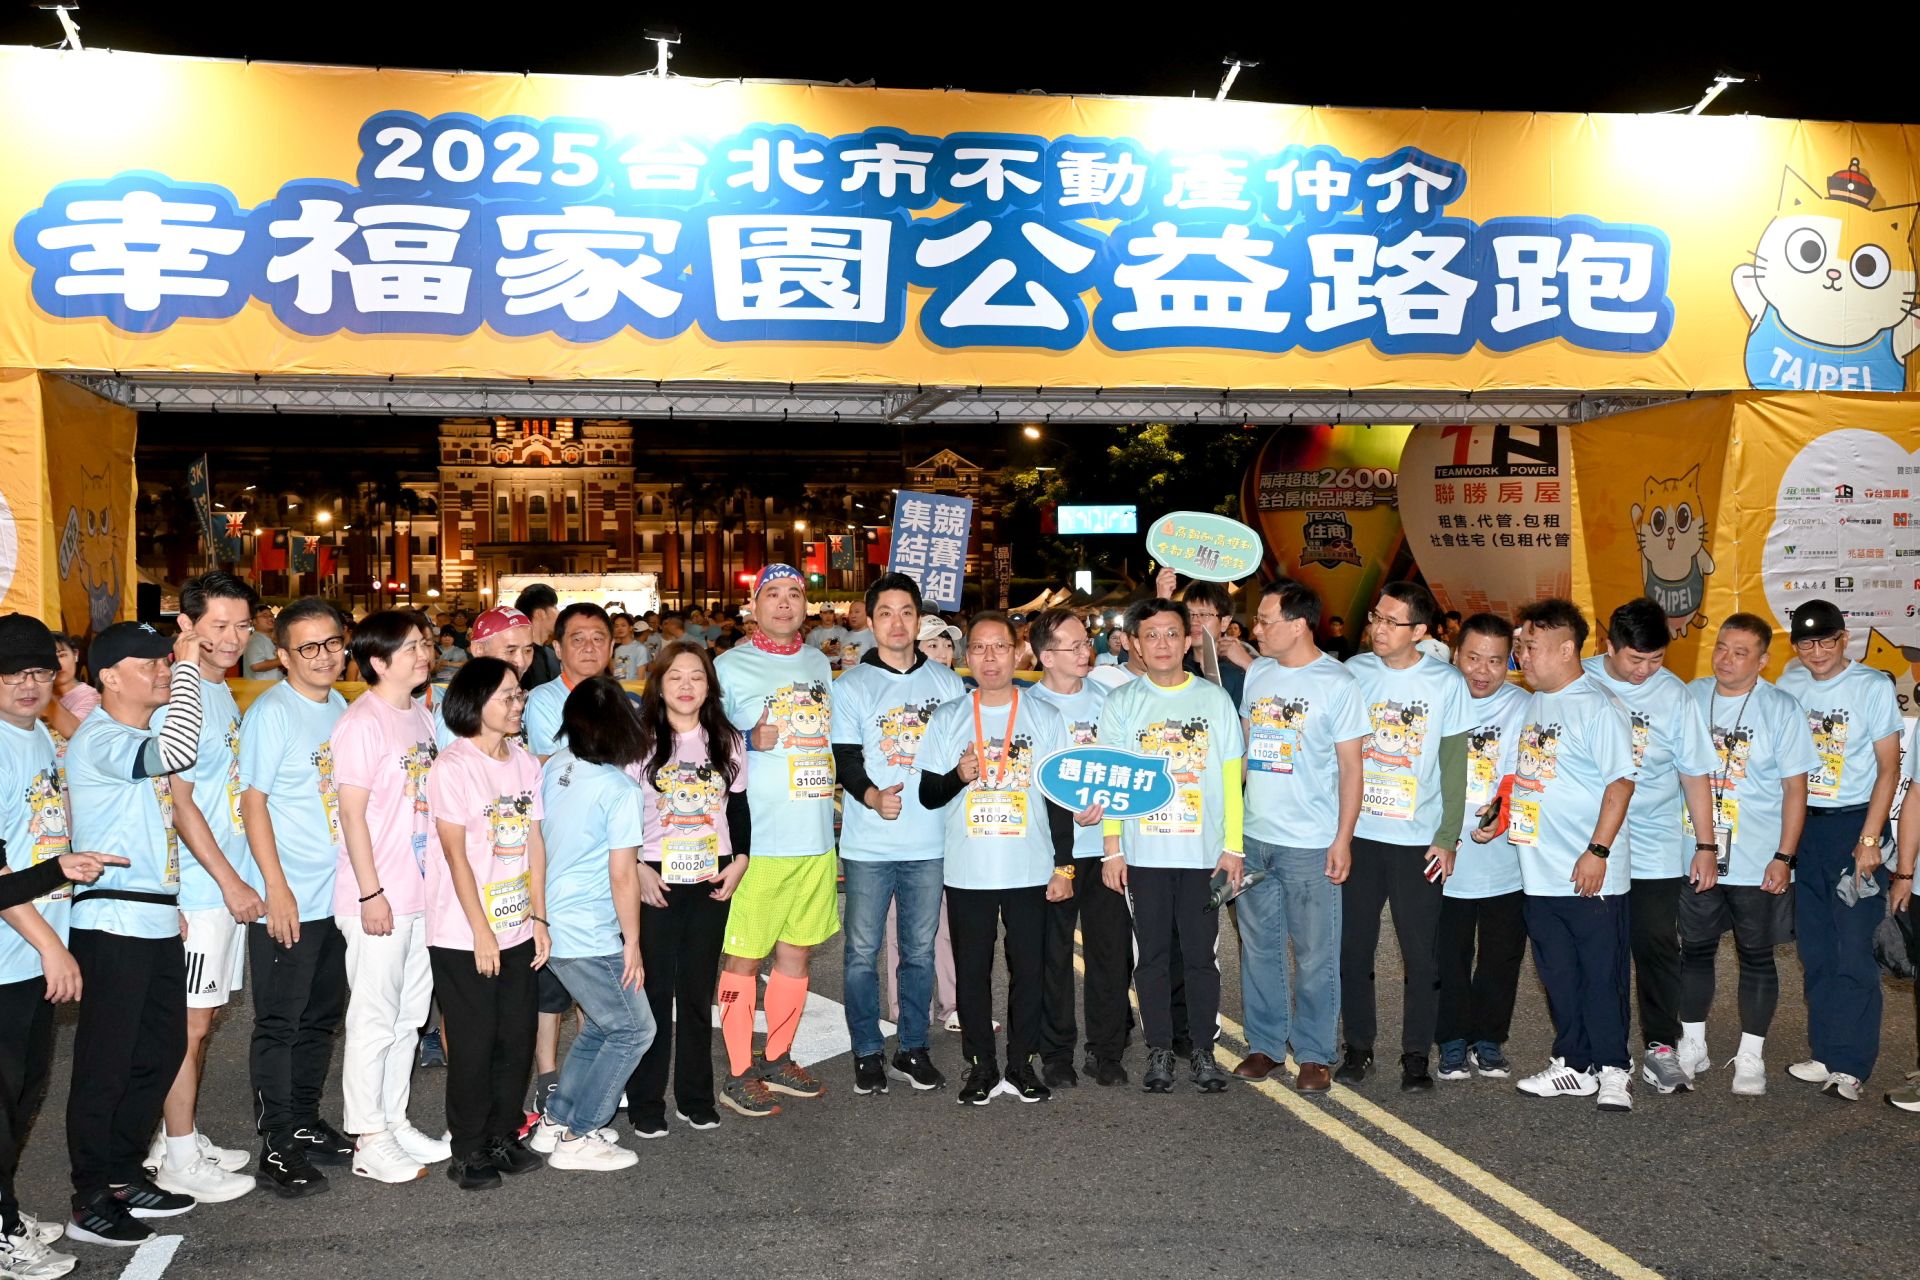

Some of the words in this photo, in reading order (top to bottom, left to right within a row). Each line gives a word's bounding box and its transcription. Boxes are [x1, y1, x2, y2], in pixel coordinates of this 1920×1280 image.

[37, 190, 1661, 335] 幸福家園公益路跑
[1770, 346, 1873, 392] TAIPEI
[190, 461, 204, 487] 3K
[1436, 467, 1499, 476] TEAMWORK
[1510, 466, 1557, 475] POWER
[1434, 481, 1561, 505] 聯勝房屋
[1307, 512, 1345, 523] TEAM
[1308, 524, 1346, 539] 住商
[924, 504, 966, 602] 競賽組
[1653, 585, 1692, 612] TAIPEI
[796, 776, 827, 786] 31005
[1058, 757, 1157, 793] 遇詐請打
[1075, 786, 1131, 812] 165
[1363, 793, 1396, 806] 00022
[972, 814, 1008, 823] 31002
[670, 859, 705, 872] 00020
